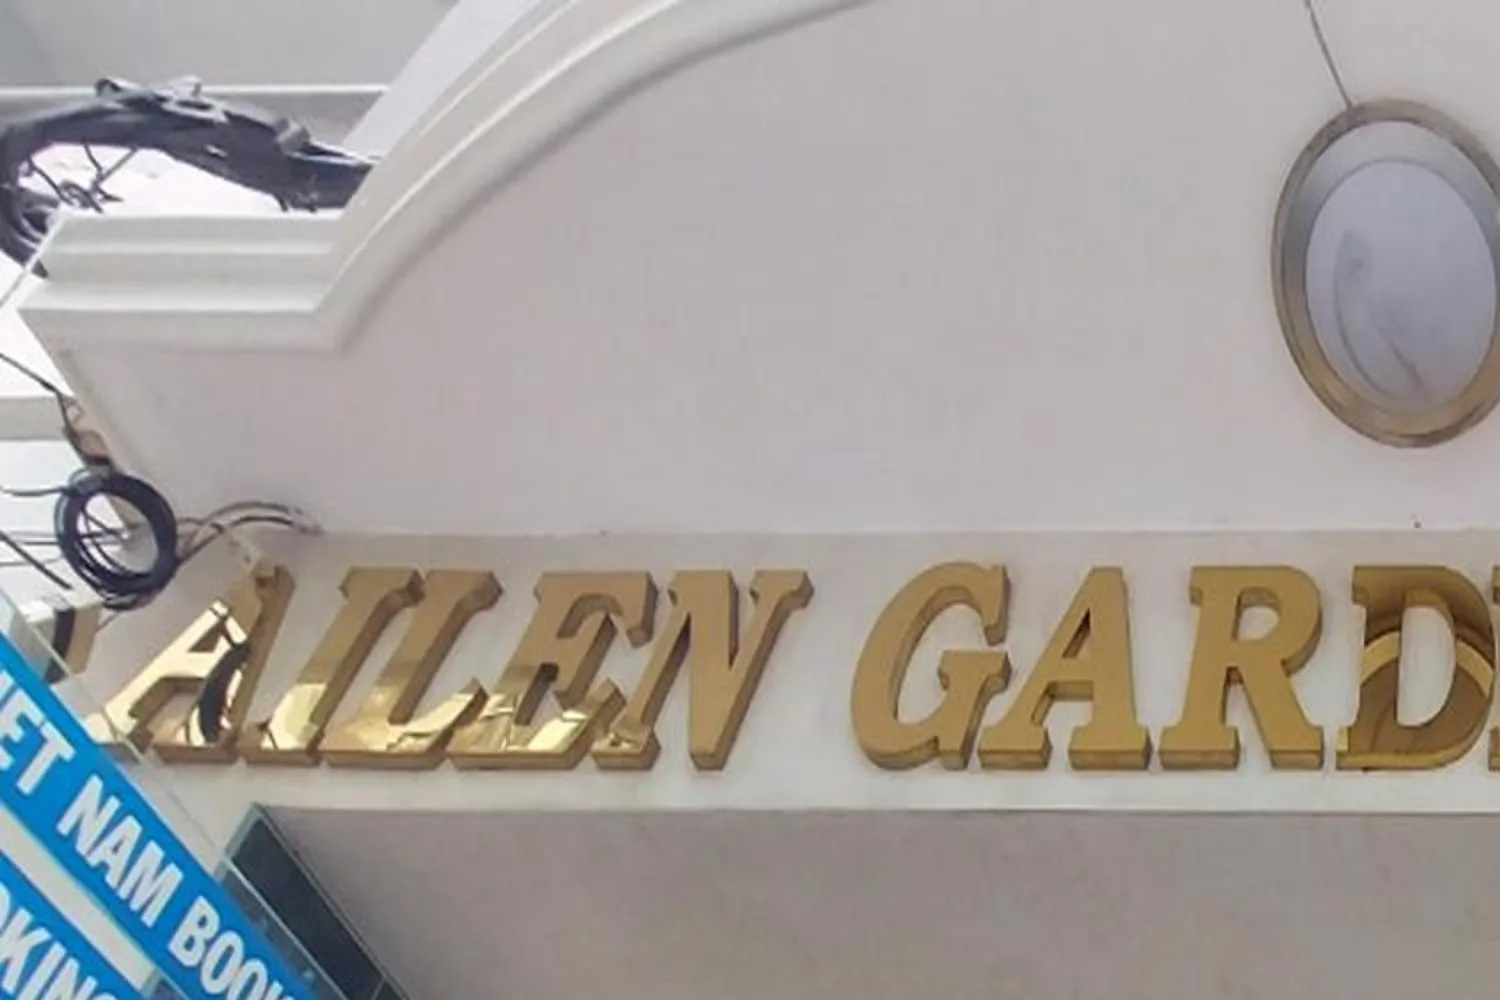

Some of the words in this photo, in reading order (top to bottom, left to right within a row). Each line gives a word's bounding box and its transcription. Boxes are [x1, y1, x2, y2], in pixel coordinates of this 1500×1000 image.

[84, 564, 814, 772] AILEN
[0, 668, 76, 796] ET
[56, 774, 184, 928] NAM
